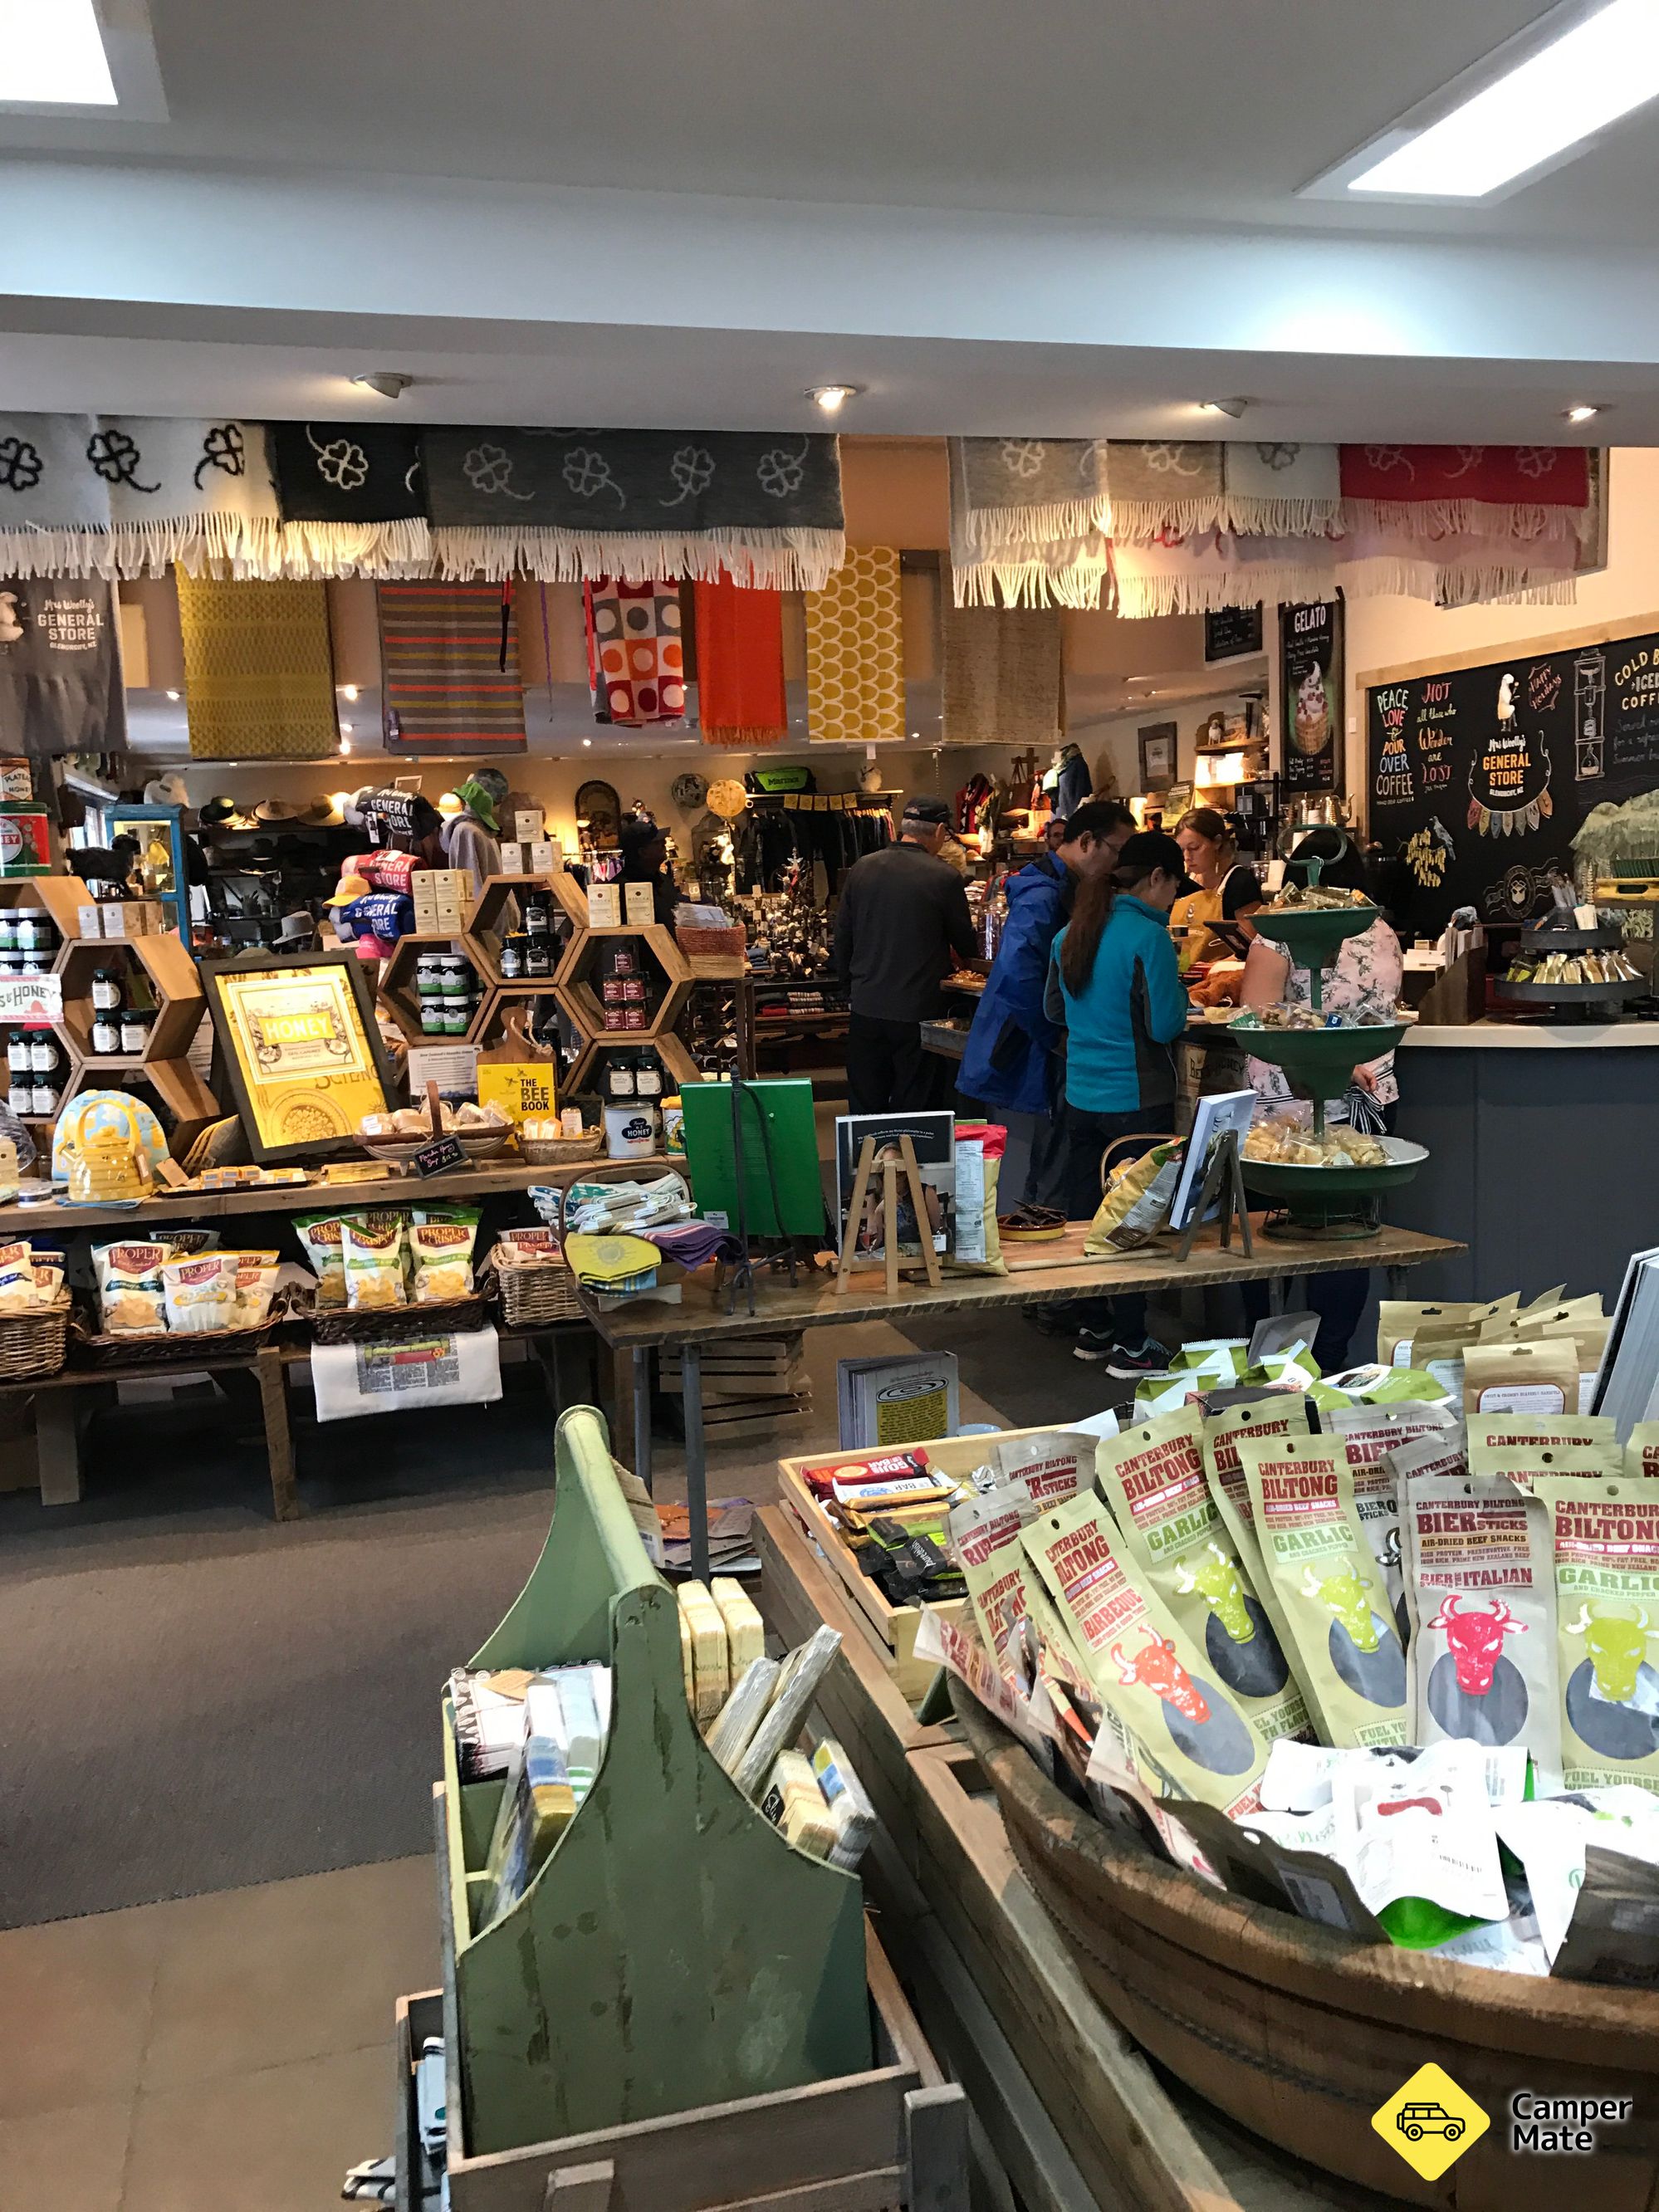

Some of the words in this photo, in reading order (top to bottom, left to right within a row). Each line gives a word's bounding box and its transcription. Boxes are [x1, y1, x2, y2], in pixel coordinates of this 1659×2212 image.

[37, 614, 104, 627] GENERAL
[1294, 605, 1326, 633] GELATO
[48, 628, 95, 640] STORE
[1615, 652, 1647, 686] COLD
[1377, 688, 1409, 713] PEACE,
[1422, 682, 1452, 703] NOT
[1622, 692, 1659, 711] COFF
[1382, 709, 1406, 727] LOVE
[1417, 709, 1427, 722] all
[1382, 739, 1406, 756] POUR
[1428, 751, 1442, 762] are
[1379, 753, 1410, 773] OVER
[1483, 752, 1531, 771] GENERAL
[1422, 763, 1453, 784] LOST
[1489, 770, 1524, 786] STORE
[1376, 772, 1414, 795] COFFEE
[374, 873, 407, 887] STORE
[13, 986, 56, 1007] HONEY
[265, 1016, 329, 1040] HONEY
[521, 1087, 550, 1101] BEE
[521, 1101, 550, 1111] BOOK
[627, 1128, 650, 1137] HONEY
[311, 1222, 340, 1238] PROP
[318, 1233, 341, 1243] CRIS
[422, 1226, 465, 1239] PROPER
[428, 1235, 458, 1245] CRISPS
[112, 1248, 161, 1263] PROPER
[181, 1260, 220, 1280] PROPER
[1045, 1456, 1077, 1470] BILTONG
[1115, 1433, 1193, 1477] CANTERBURY
[1122, 1448, 1201, 1501] BILTONG
[1258, 1460, 1334, 1476] CANTERBURY
[1406, 1452, 1465, 1479] CANTERBURY
[895, 1481, 917, 1490] BAR
[1043, 1476, 1077, 1495] STICKS
[1261, 1474, 1338, 1500] BILTONG
[1311, 1500, 1337, 1509] SNACKS
[1356, 1500, 1387, 1513] BIER
[1416, 1500, 1480, 1510] CANTERBURY
[1483, 1499, 1524, 1509] BILTONG
[1555, 1500, 1659, 1518] CANTERBUR
[989, 1510, 1020, 1529] BILTONG
[1148, 1501, 1218, 1550] GARLIC
[1417, 1512, 1477, 1534] BIER
[1477, 1520, 1528, 1530] STICKS
[1555, 1515, 1659, 1540] BILTON
[1273, 1525, 1353, 1553] GARLIC
[1422, 1539, 1464, 1548] AIR-DRIED
[1467, 1536, 1488, 1545] BEEF
[1490, 1534, 1526, 1543] SNACKS
[1420, 1573, 1453, 1583] BIER
[1463, 1568, 1533, 1587] ITALIAN
[1084, 1588, 1143, 1641] BARBEQUE
[1359, 1725, 1391, 1740] FUEL
[1565, 1771, 1599, 1784] FUEL
[1227, 1794, 1256, 1820] FUEL
